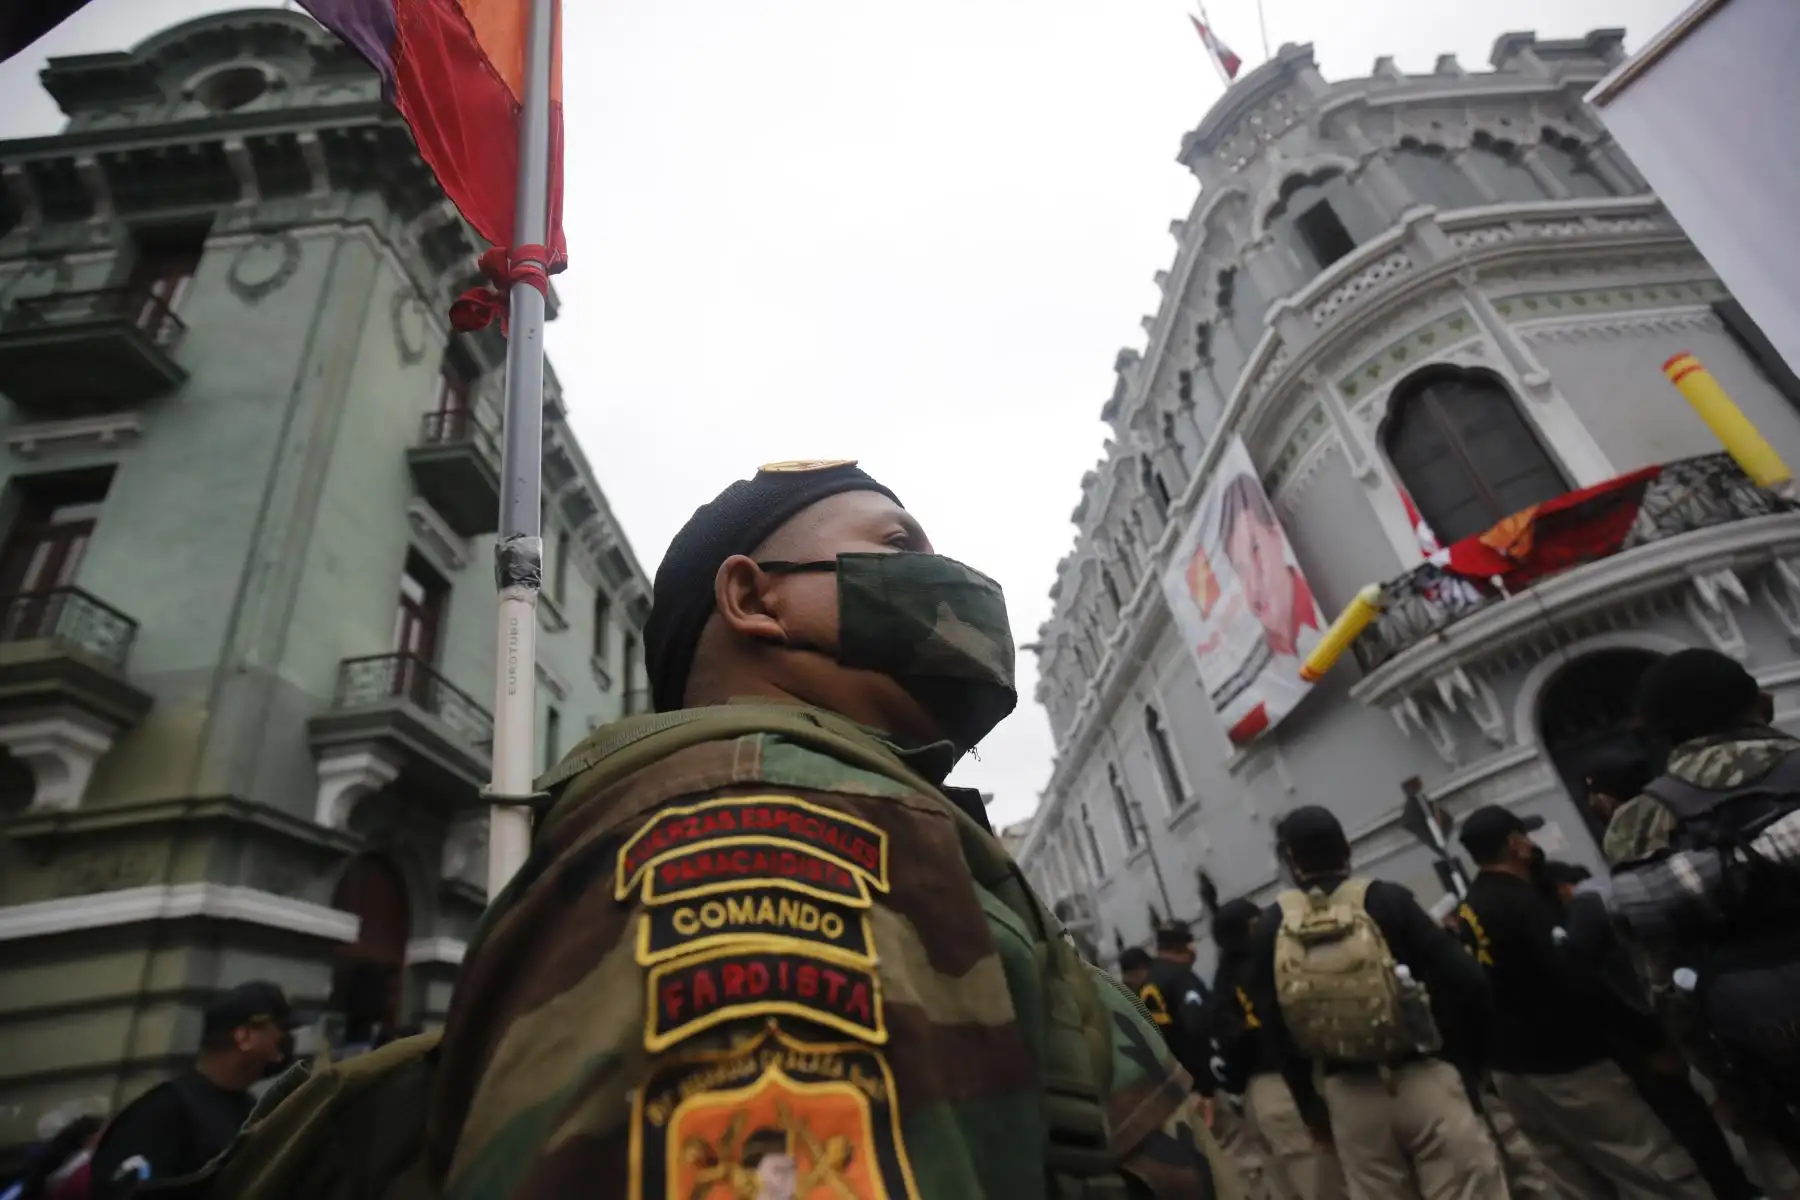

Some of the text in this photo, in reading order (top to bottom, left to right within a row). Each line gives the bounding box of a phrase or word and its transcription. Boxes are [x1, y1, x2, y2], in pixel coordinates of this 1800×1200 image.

[740, 807, 879, 869] ESPECIALES
[660, 849, 852, 885] PARACAIDISTA
[672, 896, 845, 940] COMANDO
[661, 960, 870, 1021] FARDISTA
